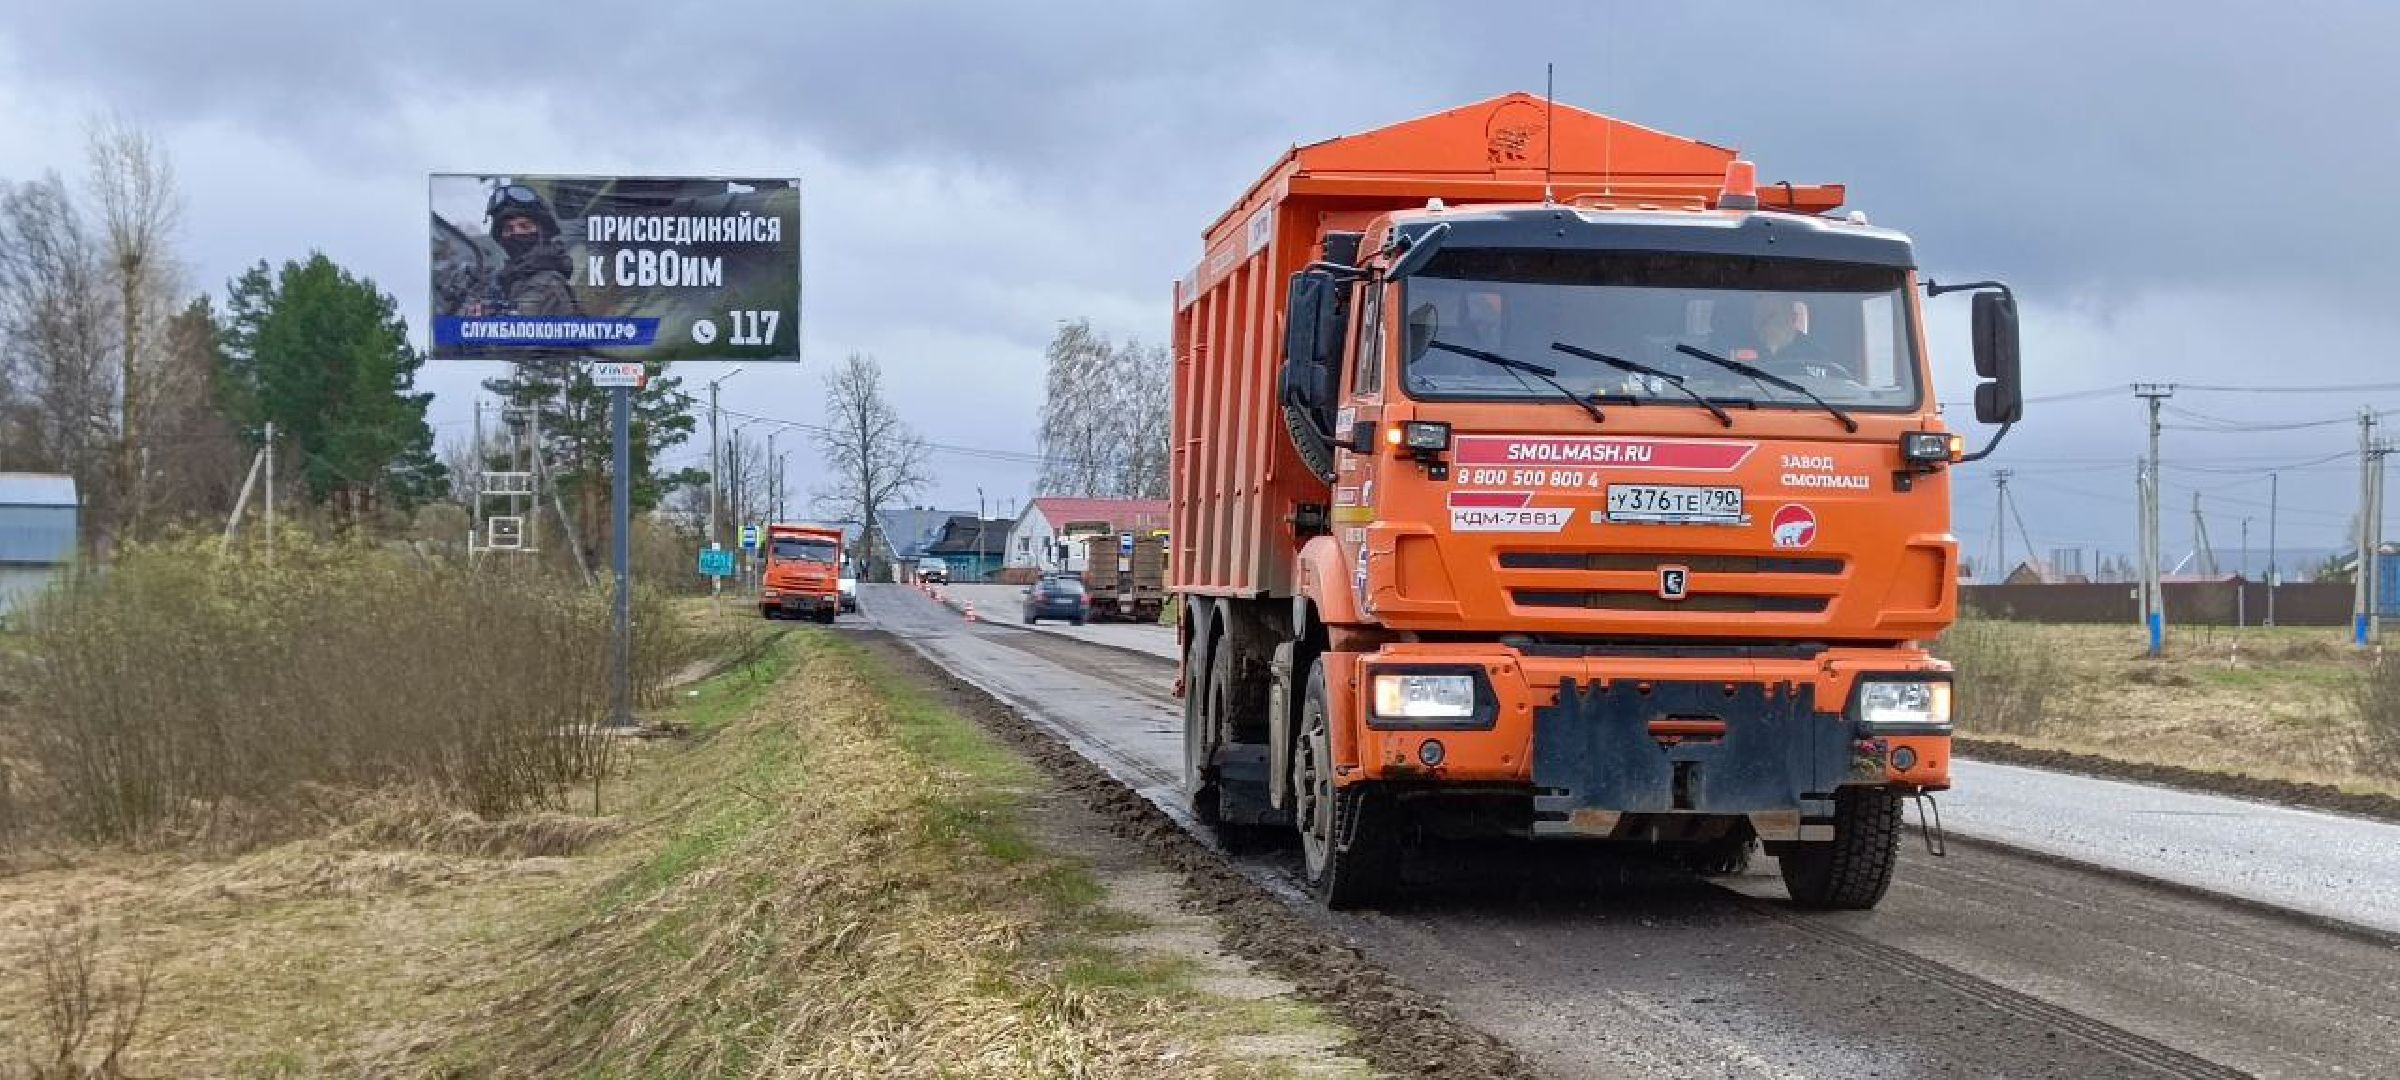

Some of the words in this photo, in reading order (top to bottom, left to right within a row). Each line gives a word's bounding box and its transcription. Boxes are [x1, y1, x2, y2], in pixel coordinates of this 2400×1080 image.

[587, 211, 781, 245] ПРИСОЕДИНЯЙСЯ
[615, 249, 722, 288] СВОим
[461, 321, 637, 340] СЛУЖБАПОКОНТРАКТУ.РФ
[728, 309, 780, 346] 117
[1507, 443, 1652, 462] SMOLMASH.RU
[1780, 454, 1834, 472] ЗАВОД
[1457, 468, 1469, 485] 8
[1473, 469, 1507, 486] 800
[1512, 470, 1546, 487] 500
[1550, 471, 1583, 488] 800
[1587, 472, 1599, 489] 4
[1780, 473, 1870, 489] СМОЛМАШ
[1703, 490, 1736, 507] 790
